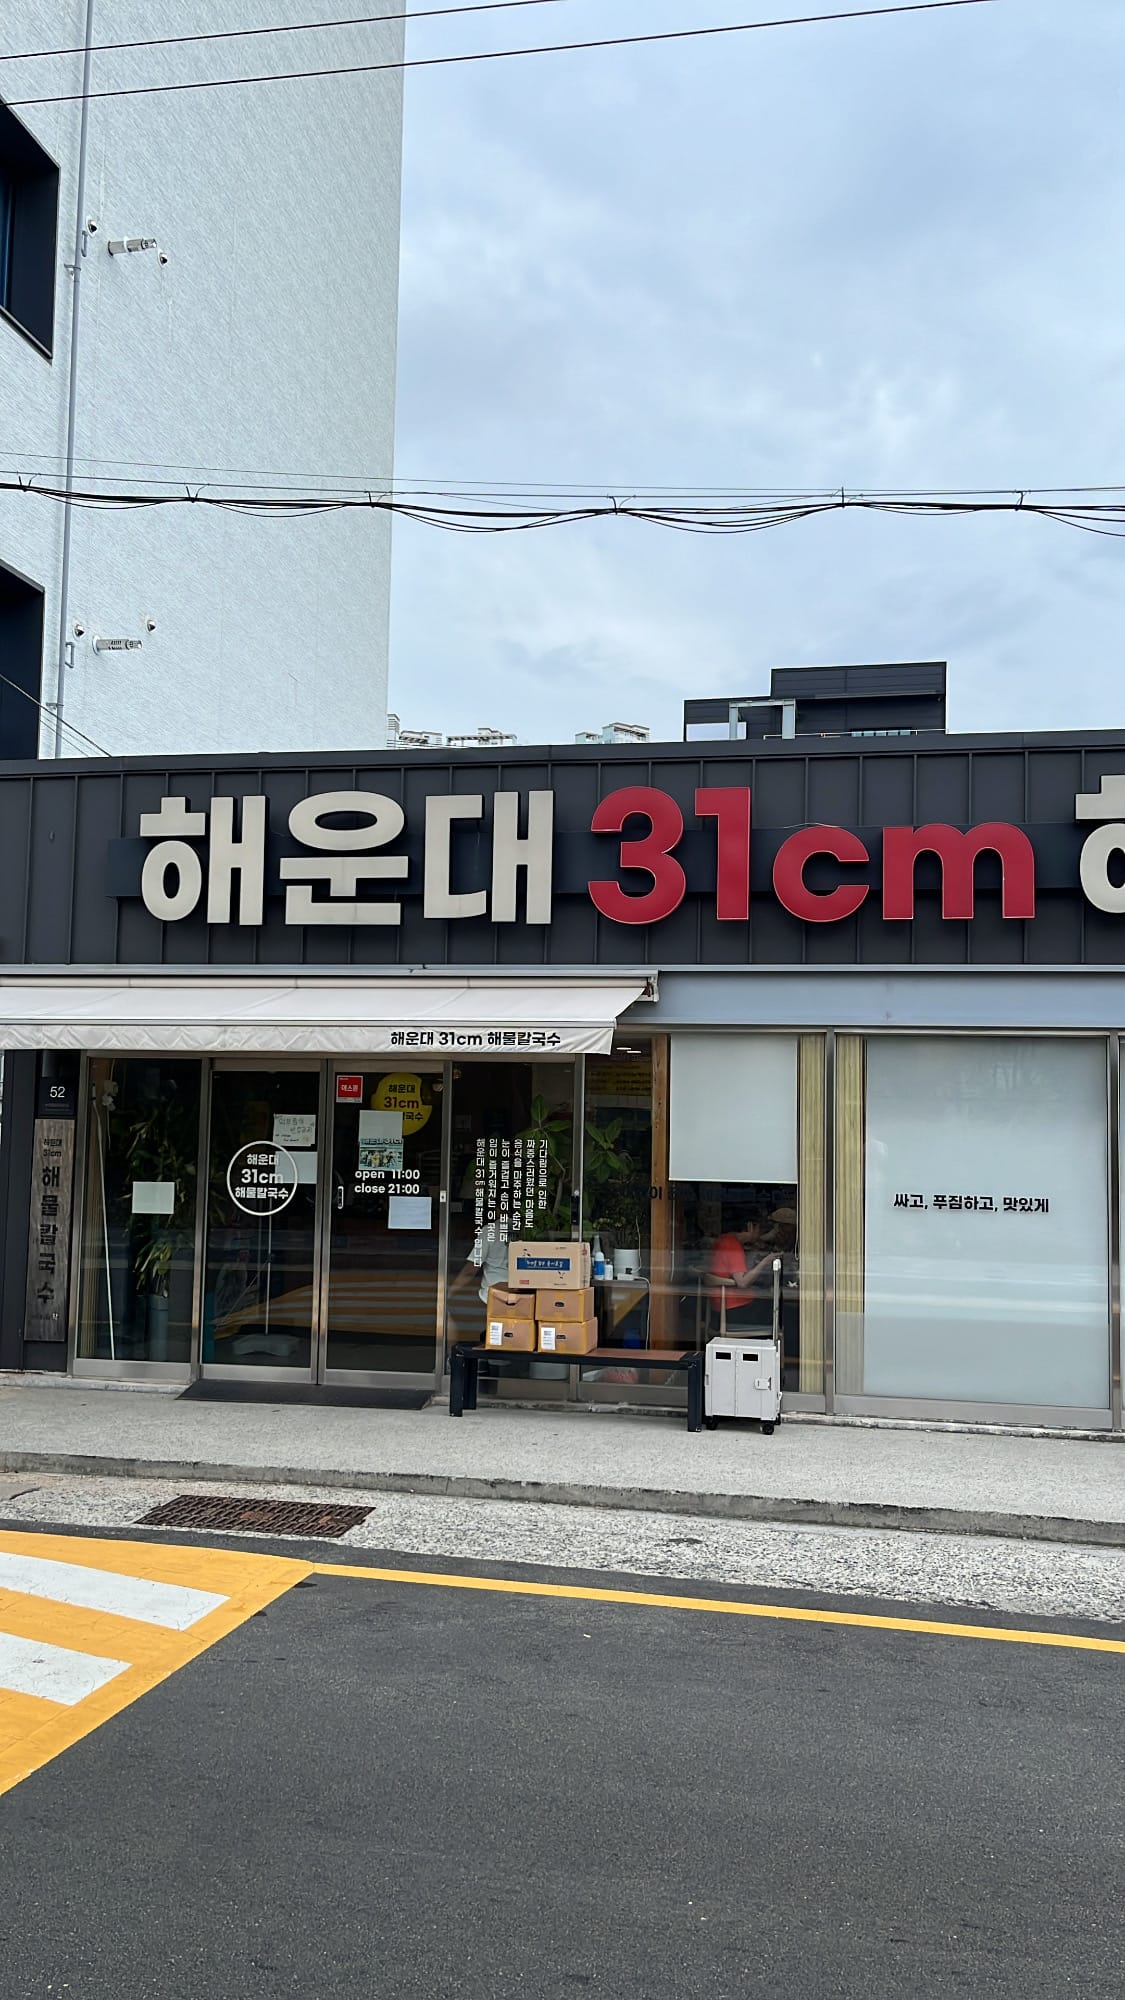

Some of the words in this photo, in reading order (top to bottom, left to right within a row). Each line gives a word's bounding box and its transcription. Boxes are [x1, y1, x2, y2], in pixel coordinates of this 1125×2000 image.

[140, 790, 554, 926] 해운대
[588, 785, 1035, 924] 31cm
[391, 1031, 433, 1046] 해운대
[438, 1031, 482, 1046] 31cm
[487, 1031, 561, 1047] 해물칼국수
[49, 1086, 66, 1098] 52
[388, 1084, 416, 1094] 해운대
[384, 1096, 420, 1109] 31cm
[476, 1138, 485, 1167] 해운대
[501, 1138, 510, 1158] 눈이
[514, 1138, 523, 1168] 음식을
[246, 1153, 279, 1166] 해운대
[538, 1139, 548, 1187] 기다림으로
[241, 1168, 284, 1184] 31cm
[354, 1170, 385, 1181] open
[392, 1169, 421, 1180] 11:00
[500, 1160, 510, 1189] 즐겁고
[235, 1186, 289, 1199] 해물칼국수
[354, 1183, 386, 1194] close
[387, 1183, 420, 1194] 21:00
[513, 1171, 522, 1209] 마주하는
[500, 1193, 509, 1211] 손이
[538, 1190, 547, 1209] 인한
[893, 1193, 929, 1210] 싸고,
[932, 1194, 998, 1213] 푸짐하고,
[1002, 1197, 1049, 1213] 맛있게
[512, 1211, 521, 1231] 순간
[524, 1200, 534, 1228] 마음도
[37, 1166, 59, 1304] 해물칼국수
